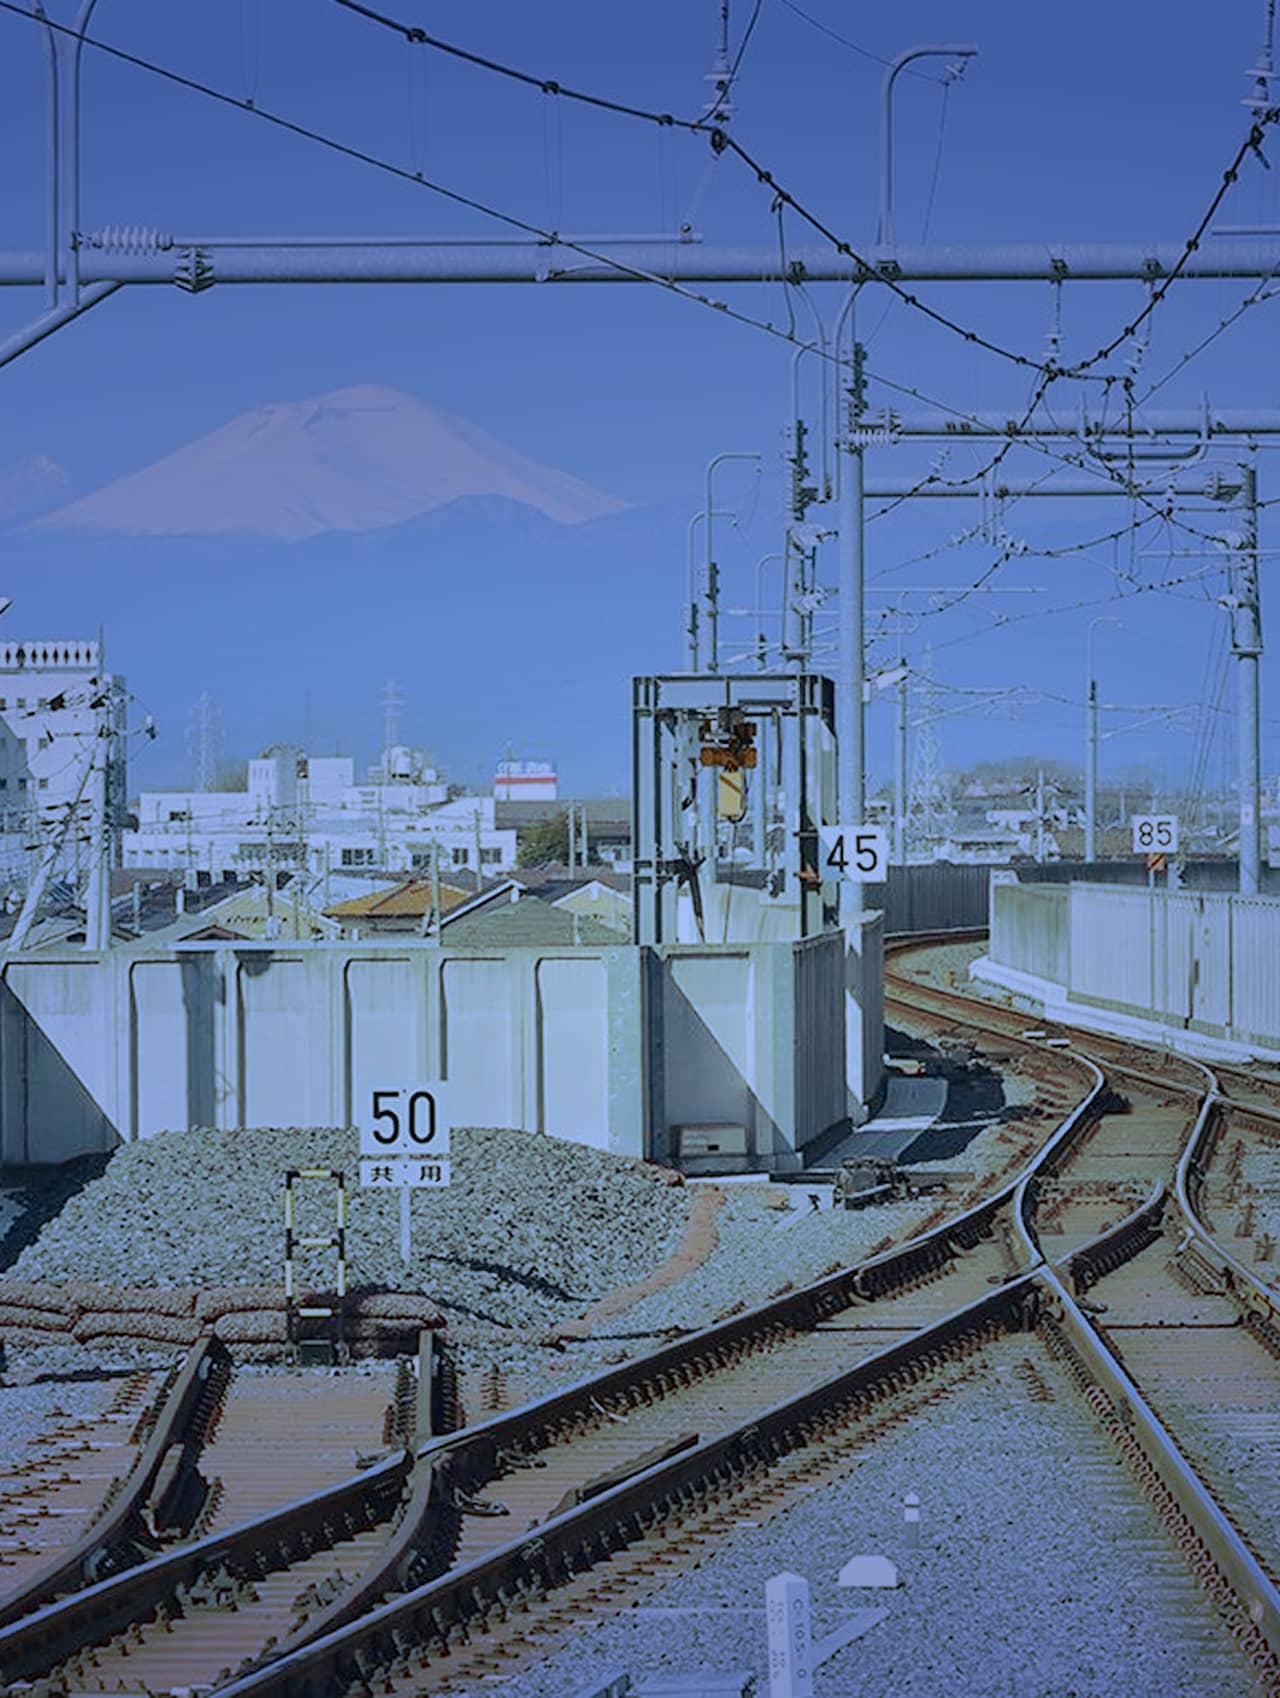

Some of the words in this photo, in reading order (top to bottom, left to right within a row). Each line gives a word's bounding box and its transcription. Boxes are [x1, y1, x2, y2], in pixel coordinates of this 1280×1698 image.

[1139, 822, 1171, 846] 85
[827, 835, 877, 872] 45
[373, 1091, 436, 1144] 50
[371, 1166, 442, 1182] 共用
